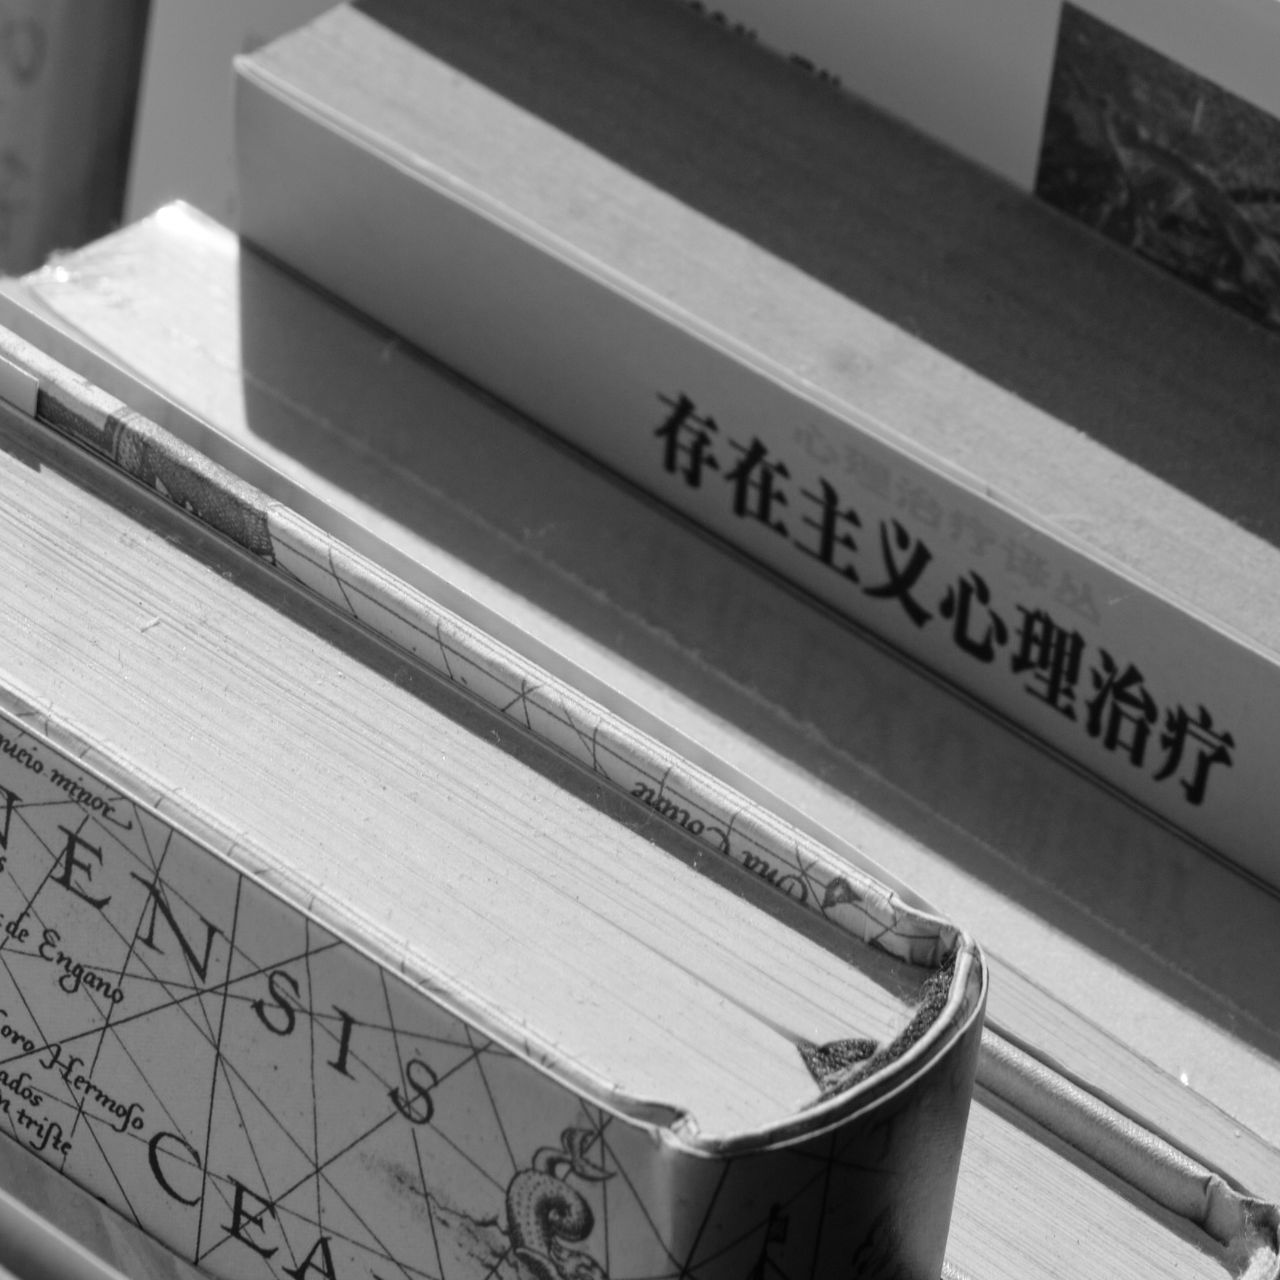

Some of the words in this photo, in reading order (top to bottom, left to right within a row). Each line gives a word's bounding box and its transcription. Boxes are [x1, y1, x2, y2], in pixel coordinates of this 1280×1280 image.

[653, 390, 1236, 807] 存在主义心理治疗
